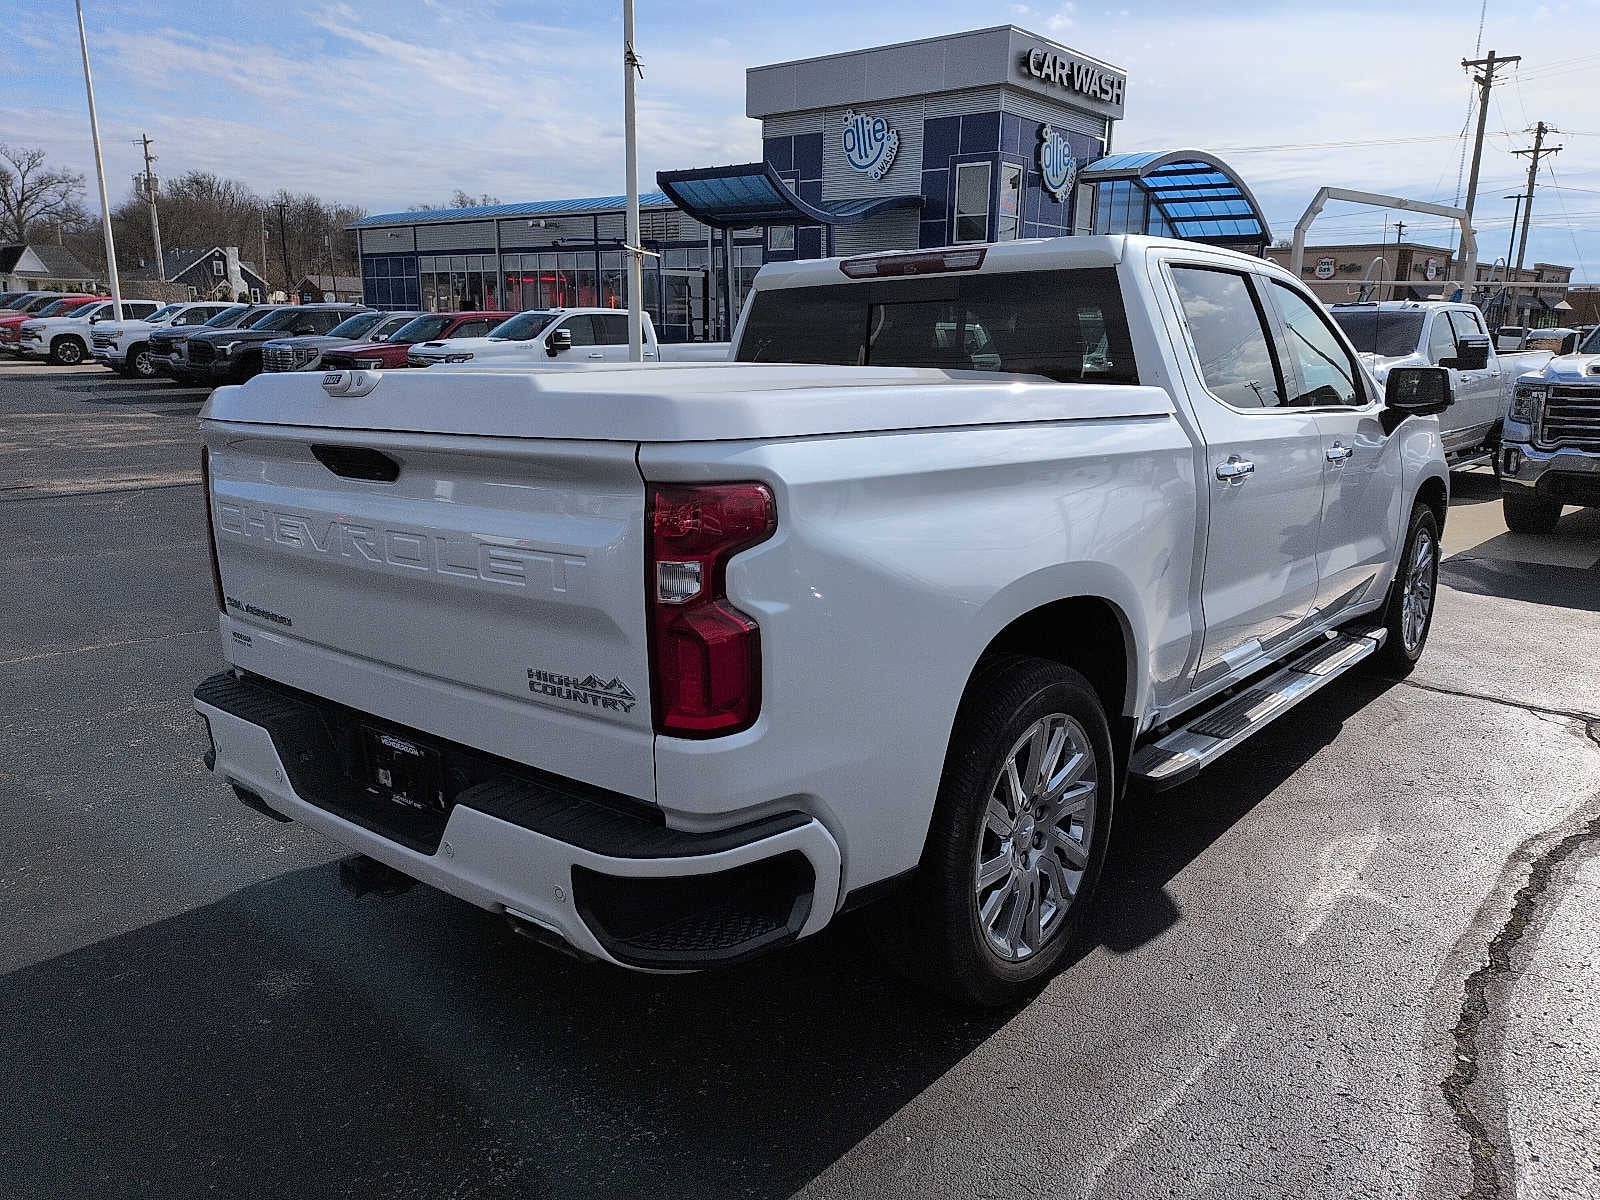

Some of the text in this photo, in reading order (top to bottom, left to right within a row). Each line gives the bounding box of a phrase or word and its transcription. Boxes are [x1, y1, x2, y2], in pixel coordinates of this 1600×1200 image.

[1029, 47, 1126, 105] CAR WASH
[843, 116, 886, 159] ollie
[877, 145, 896, 173] WASH
[1044, 133, 1070, 178] ollie
[217, 500, 587, 593] CHEVROLET
[526, 667, 580, 689] HIGH
[528, 680, 637, 714] COUNTRY
